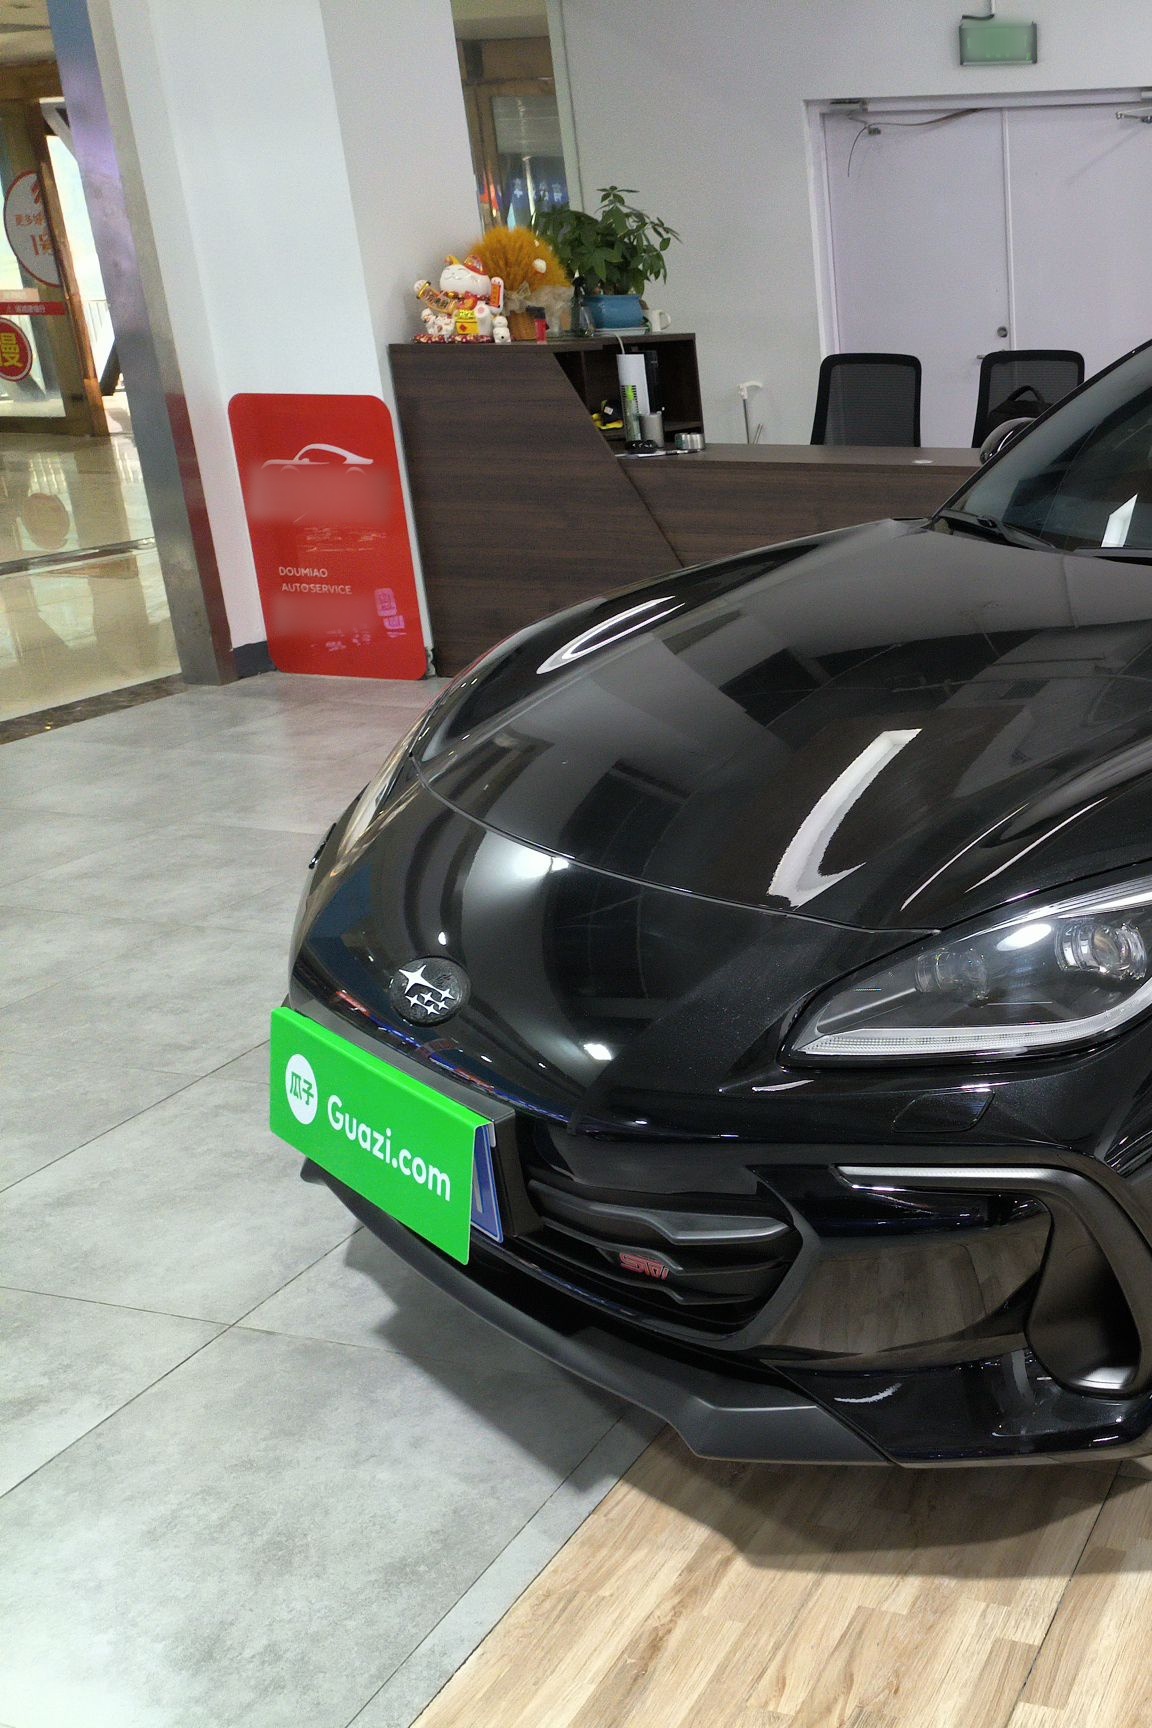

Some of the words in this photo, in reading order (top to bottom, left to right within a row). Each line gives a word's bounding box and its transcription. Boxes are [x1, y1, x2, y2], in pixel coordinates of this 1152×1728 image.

[279, 566, 328, 578] DOUMIAO
[290, 1071, 314, 1105] 瓜子
[327, 1094, 451, 1202] Guazi.com
